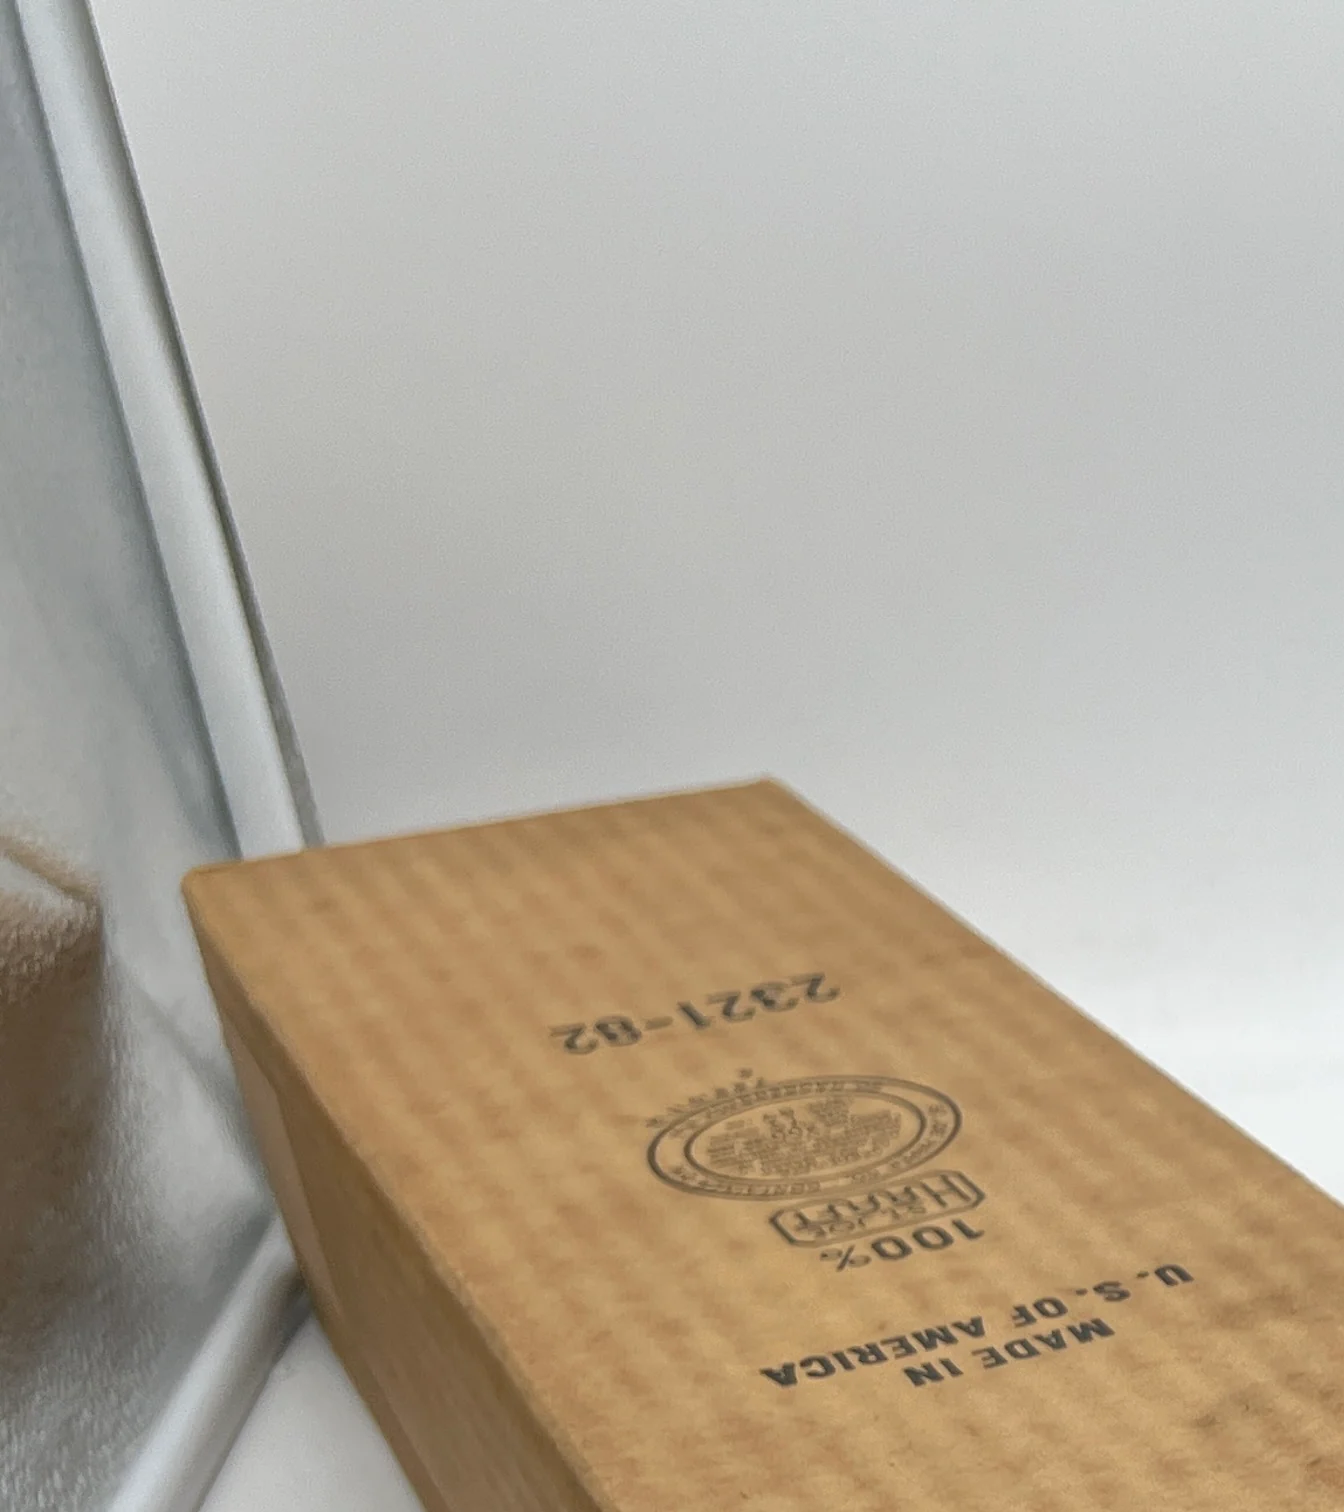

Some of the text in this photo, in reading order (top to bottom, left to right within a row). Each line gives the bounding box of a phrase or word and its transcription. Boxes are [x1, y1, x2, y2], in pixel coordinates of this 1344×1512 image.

[820, 1219, 985, 1272] 100%
[1011, 1297, 1068, 1328] OF
[759, 1316, 986, 1387] AMERICA
[904, 1318, 1115, 1387] MADE IN
